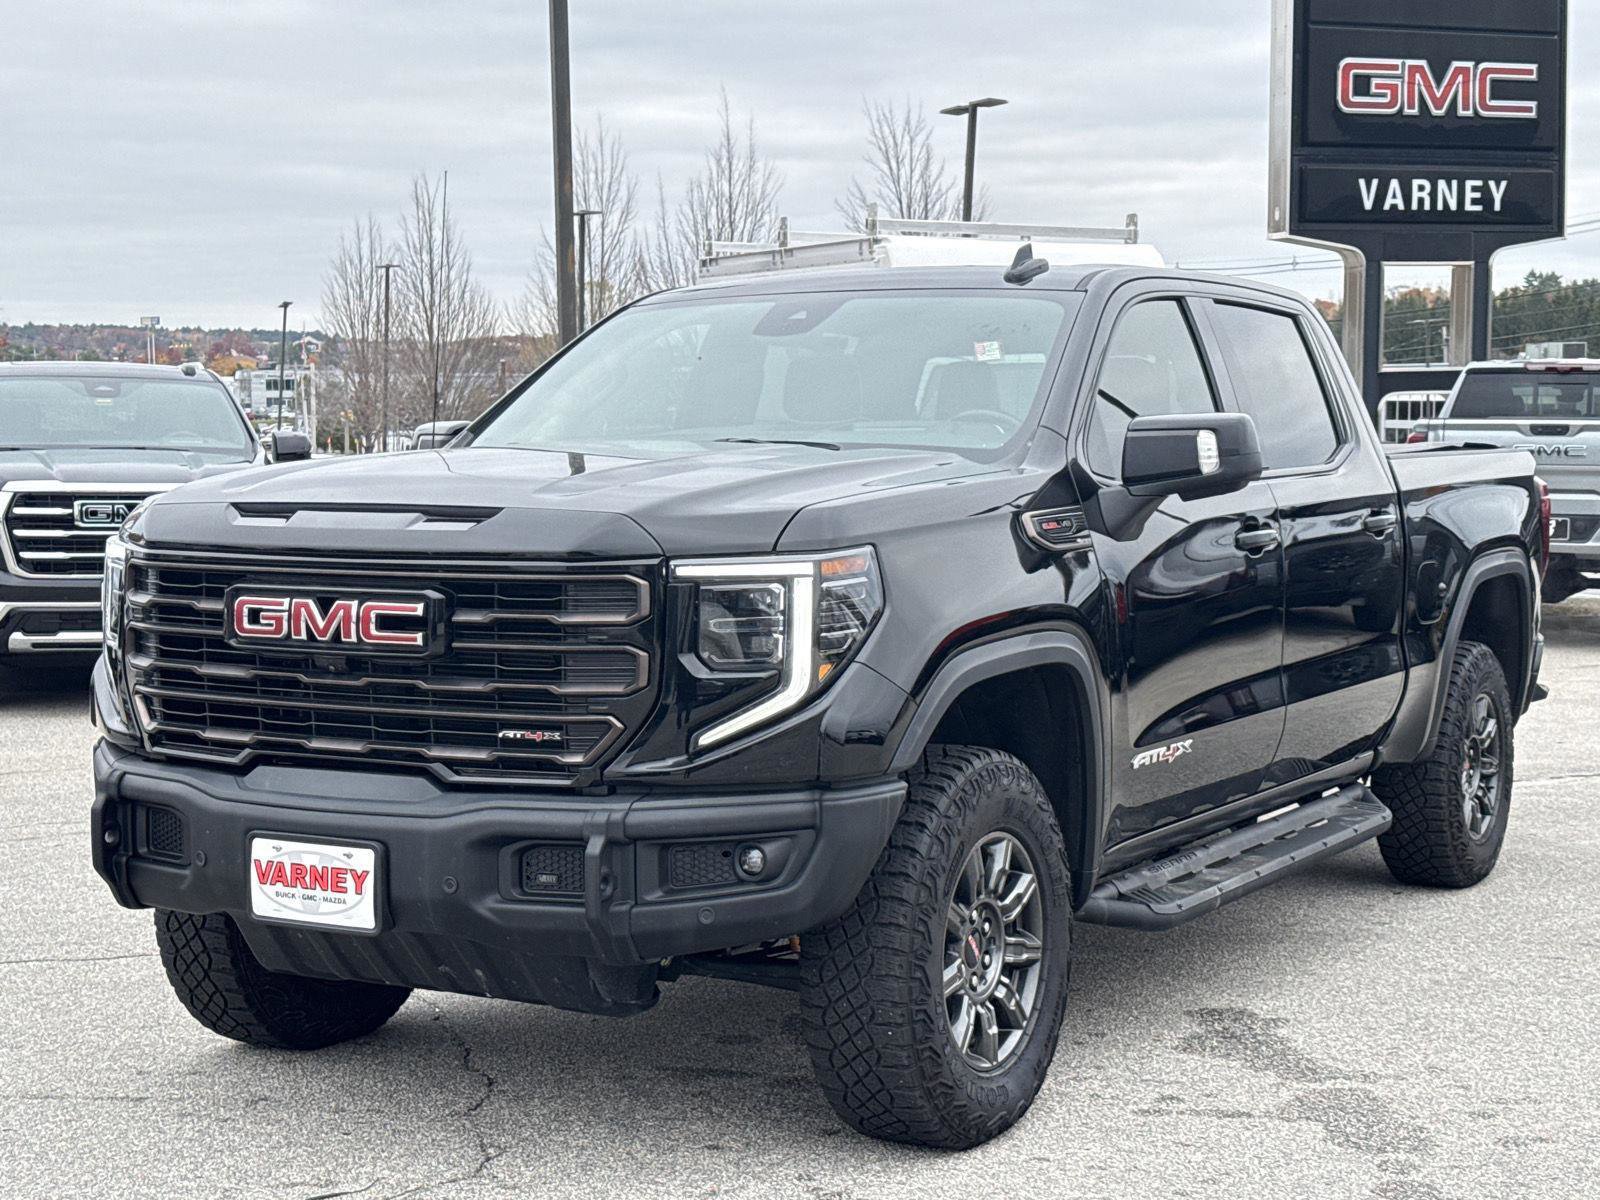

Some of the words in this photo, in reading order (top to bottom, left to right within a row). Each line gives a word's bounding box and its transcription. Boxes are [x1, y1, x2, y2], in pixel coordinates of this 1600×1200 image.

[1337, 57, 1538, 118] GMC
[1358, 178, 1508, 211] VARNEY
[234, 596, 425, 646] GMC
[498, 730, 562, 742] AT4X
[1131, 739, 1194, 769] AT4X
[254, 859, 370, 895] VARNEY
[275, 891, 296, 899] BUICK
[302, 894, 317, 902] GMC
[322, 896, 347, 905] MAZDA
